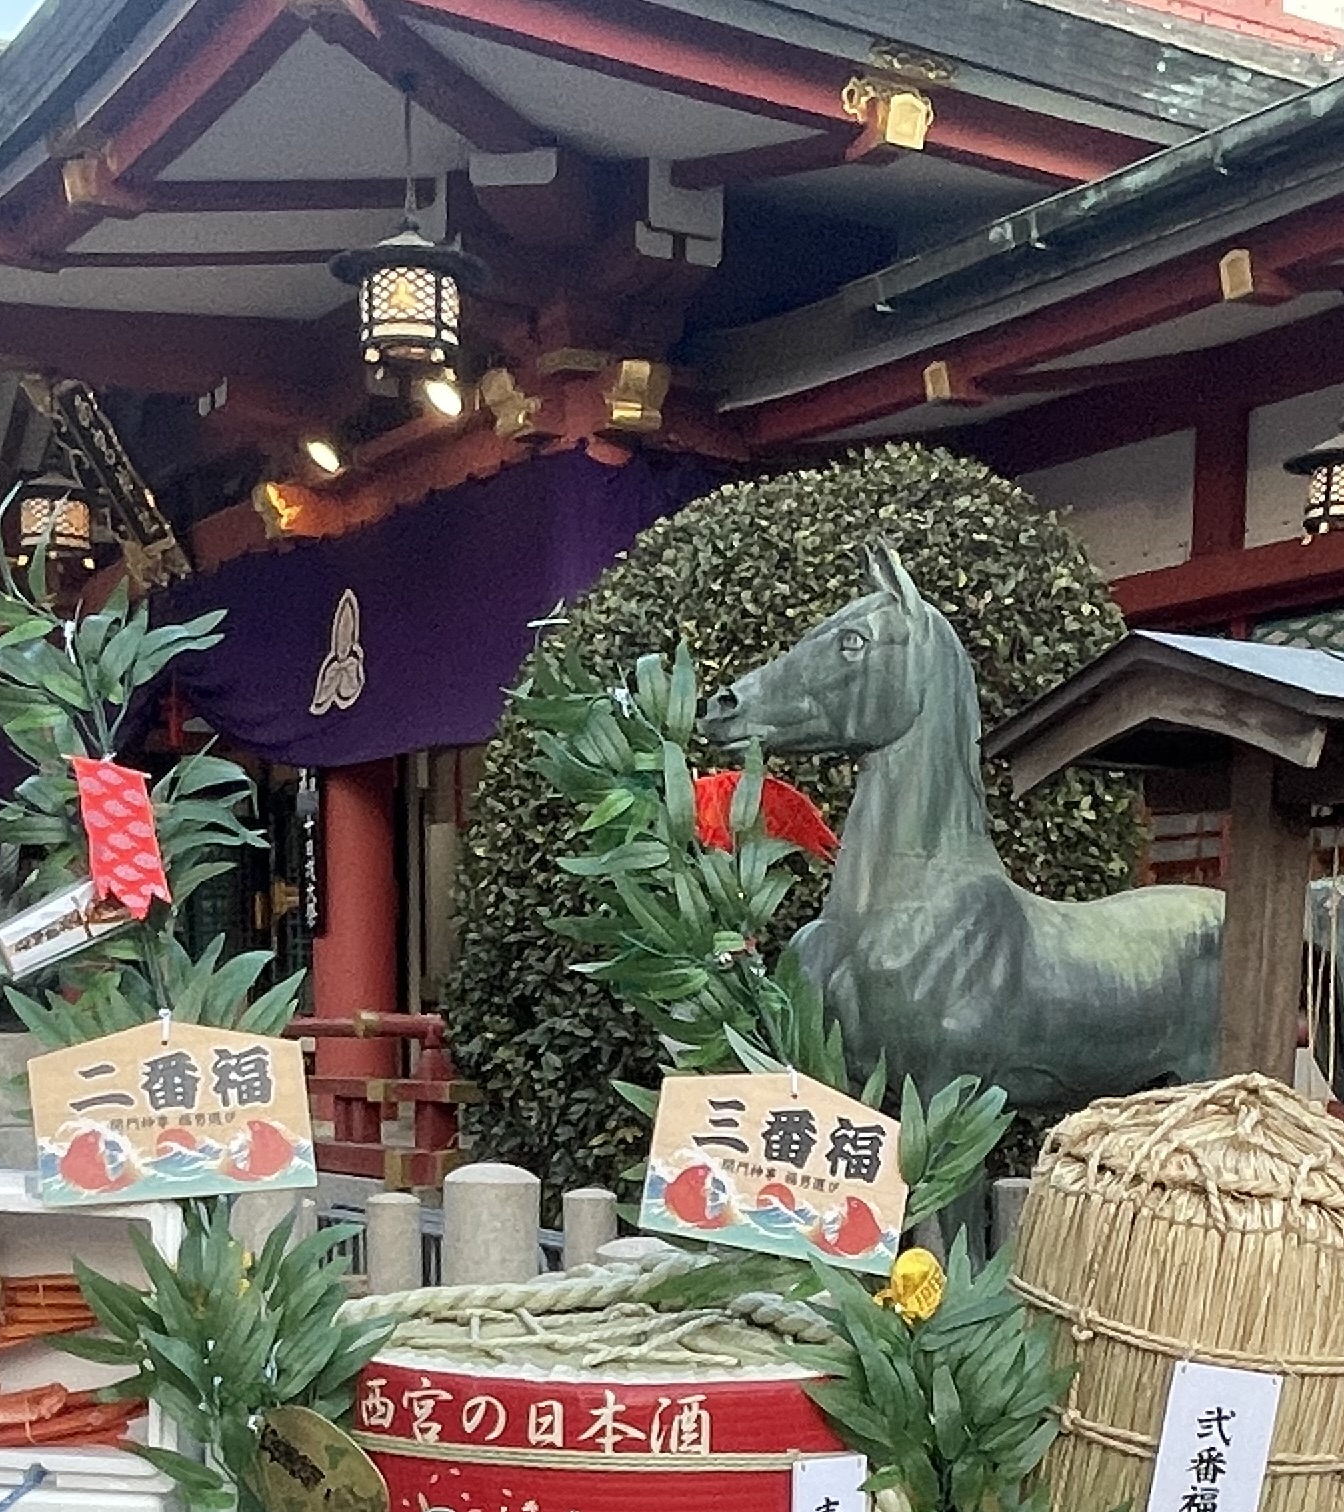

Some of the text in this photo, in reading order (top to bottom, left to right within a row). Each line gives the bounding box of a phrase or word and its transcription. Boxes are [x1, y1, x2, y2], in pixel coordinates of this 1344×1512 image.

[68, 1043, 274, 1113] 二番福
[691, 1098, 887, 1184] 三番福
[360, 1377, 712, 1455] 西宮の日本酒
